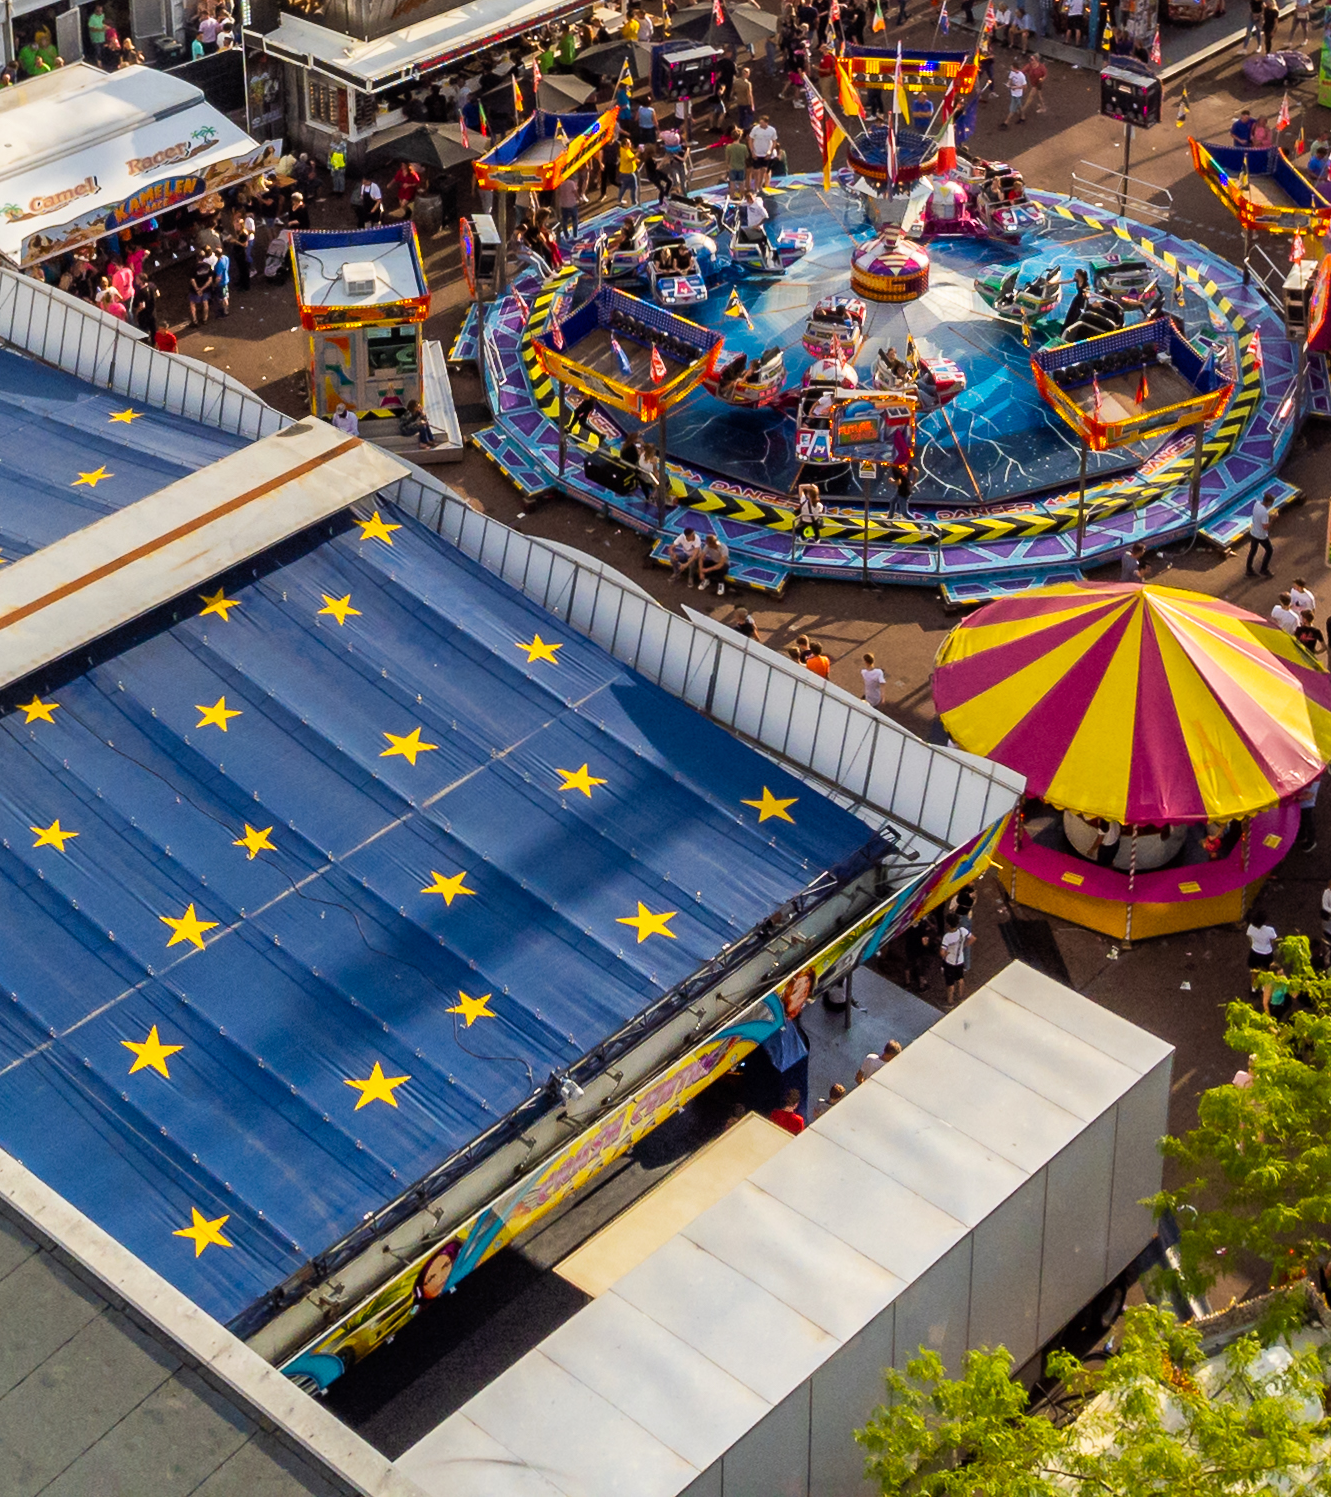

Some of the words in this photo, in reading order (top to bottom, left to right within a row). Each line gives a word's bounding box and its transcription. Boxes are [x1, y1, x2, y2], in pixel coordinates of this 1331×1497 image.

[125, 141, 192, 177] Racer
[28, 175, 102, 214] Camel
[114, 176, 198, 223] KAMELEN
[709, 479, 807, 510] DANGER
[935, 503, 1035, 522] DANGER
